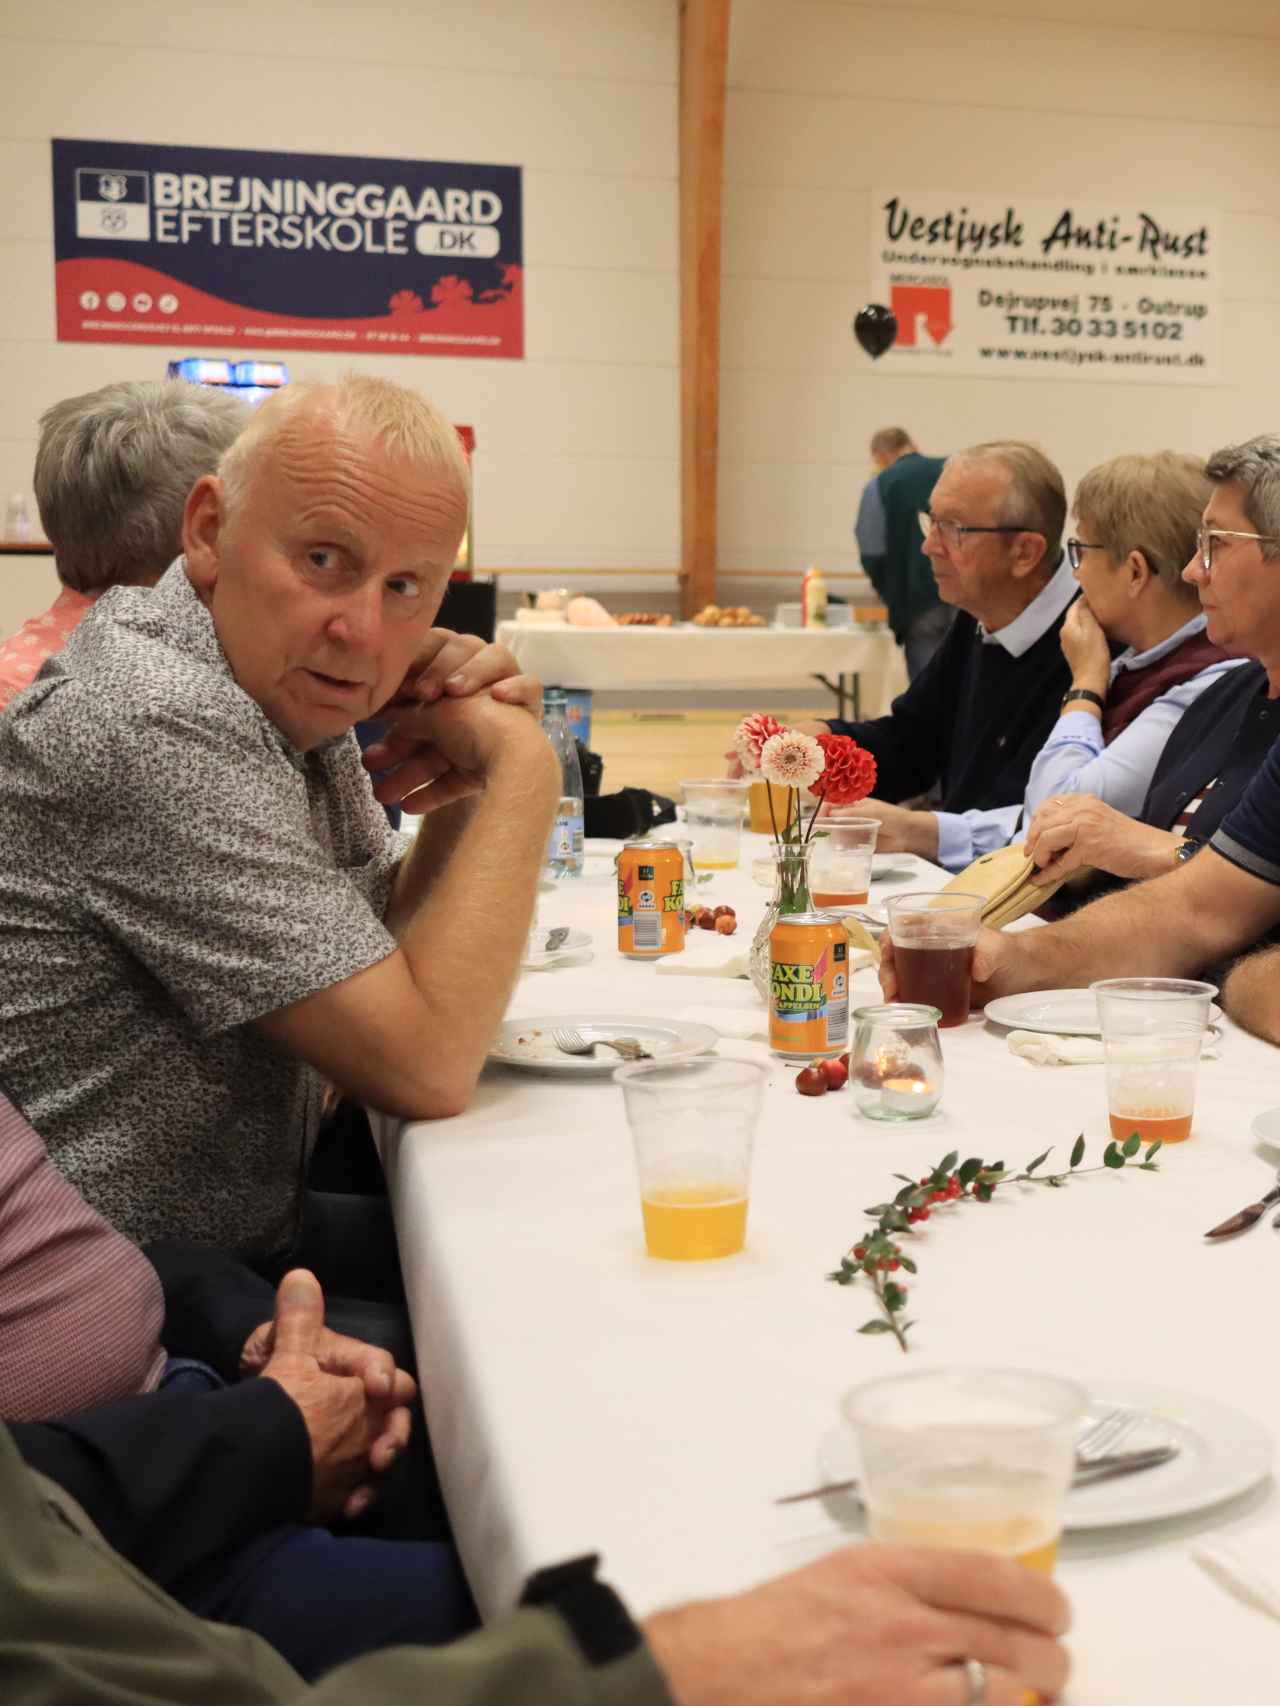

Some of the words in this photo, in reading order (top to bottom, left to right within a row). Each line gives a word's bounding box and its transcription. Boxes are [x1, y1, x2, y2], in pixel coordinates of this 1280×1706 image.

[153, 172, 503, 224] BREJNINGGAARD
[155, 208, 409, 255] EFTERSKOLE
[884, 197, 1023, 253] Vestjysk
[1042, 208, 1209, 259] Anti-Rust
[978, 289, 1080, 315] Dejrupvej
[1089, 295, 1113, 313] 75
[1137, 297, 1208, 320] Outrup
[772, 982, 821, 1002] ONDI
[773, 963, 813, 983] AXE
